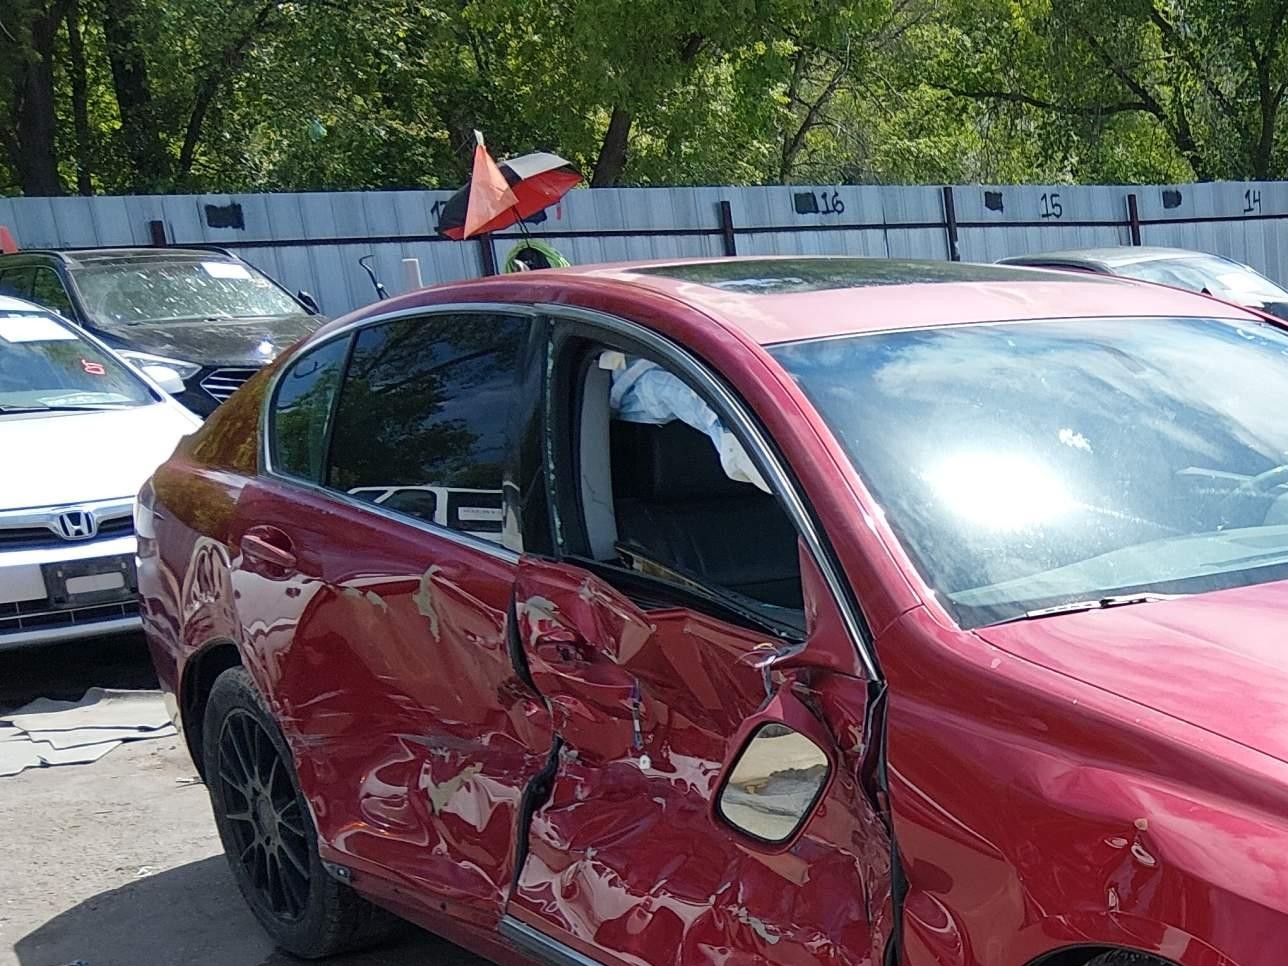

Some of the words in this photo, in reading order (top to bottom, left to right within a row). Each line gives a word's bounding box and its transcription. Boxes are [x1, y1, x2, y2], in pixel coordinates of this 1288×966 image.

[821, 191, 845, 215] 16
[1040, 193, 1063, 219] 15
[1244, 189, 1262, 214] 14
